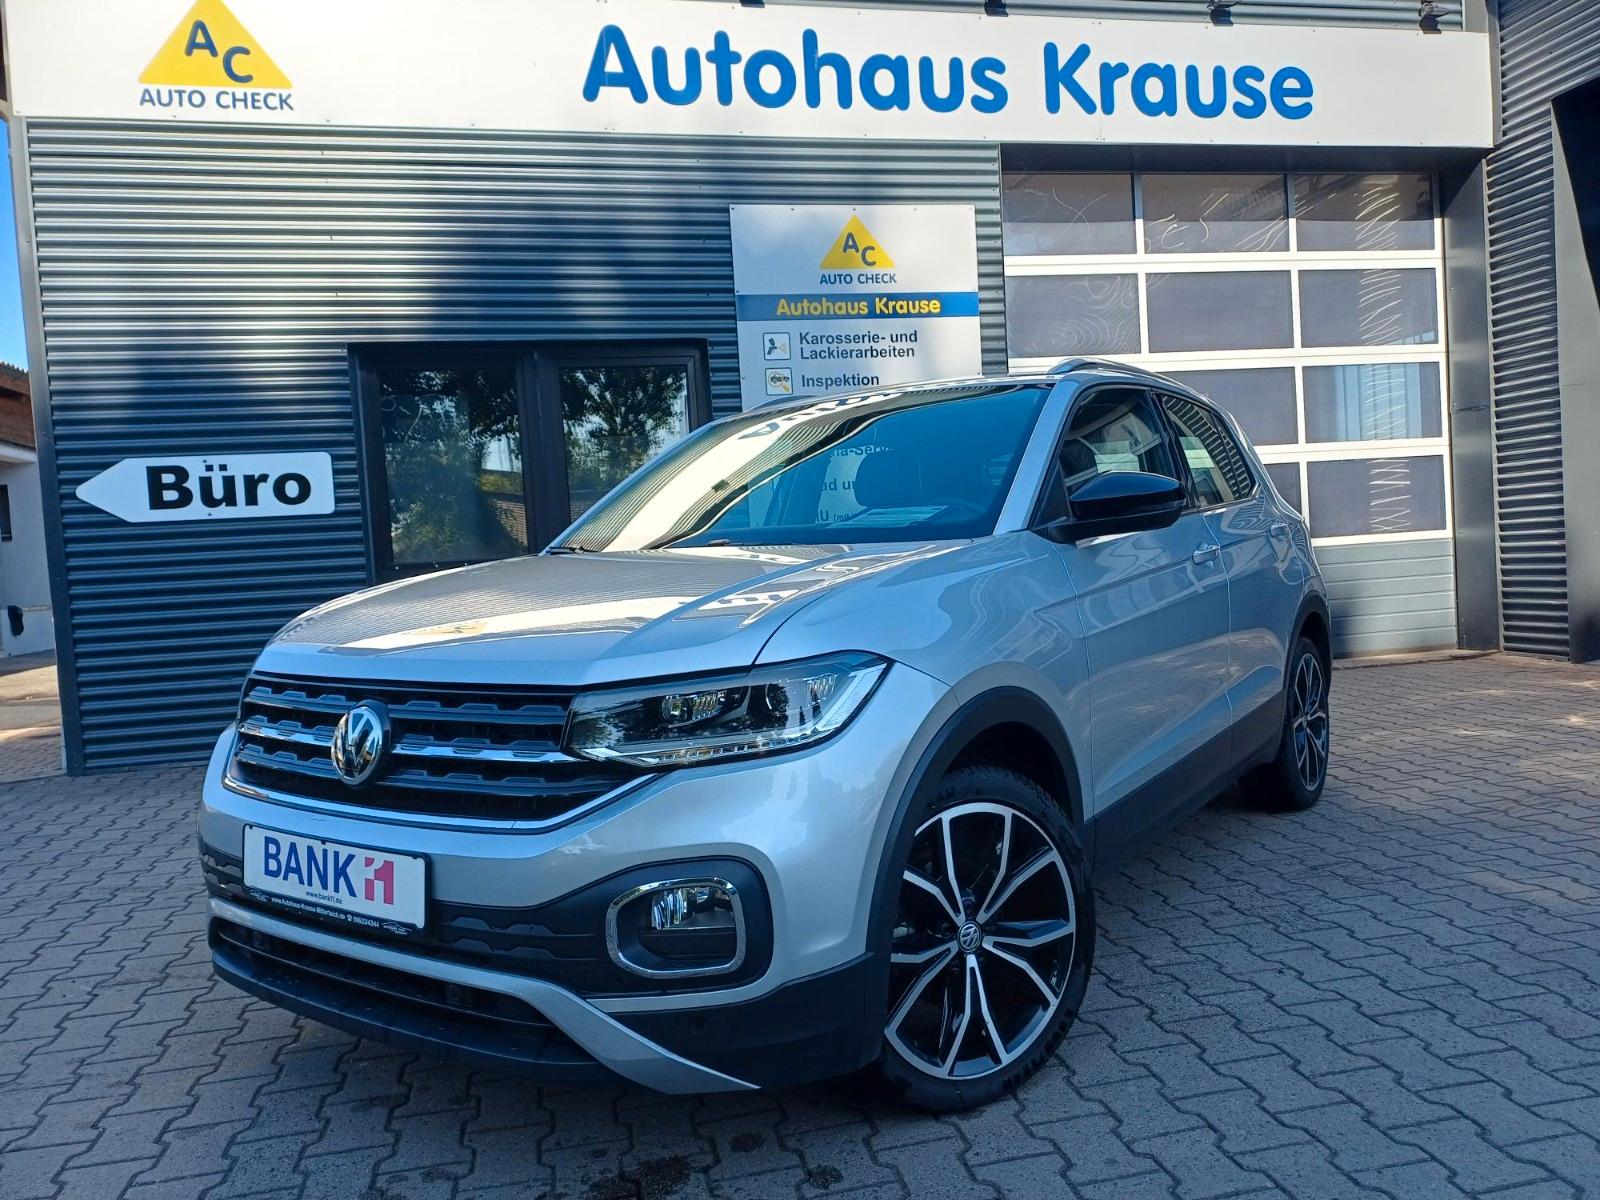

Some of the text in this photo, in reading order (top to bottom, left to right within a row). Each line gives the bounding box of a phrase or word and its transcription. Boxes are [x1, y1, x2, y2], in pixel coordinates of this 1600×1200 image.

[582, 25, 1314, 120] Autohaus Krause
[139, 88, 294, 111] AUTO CHECK
[819, 272, 897, 285] AUTO CHECK
[776, 297, 941, 316] Autohaus Krause
[800, 346, 915, 360] Lackierarbeiten
[801, 374, 880, 390] Inspektion
[146, 463, 312, 511] Büro
